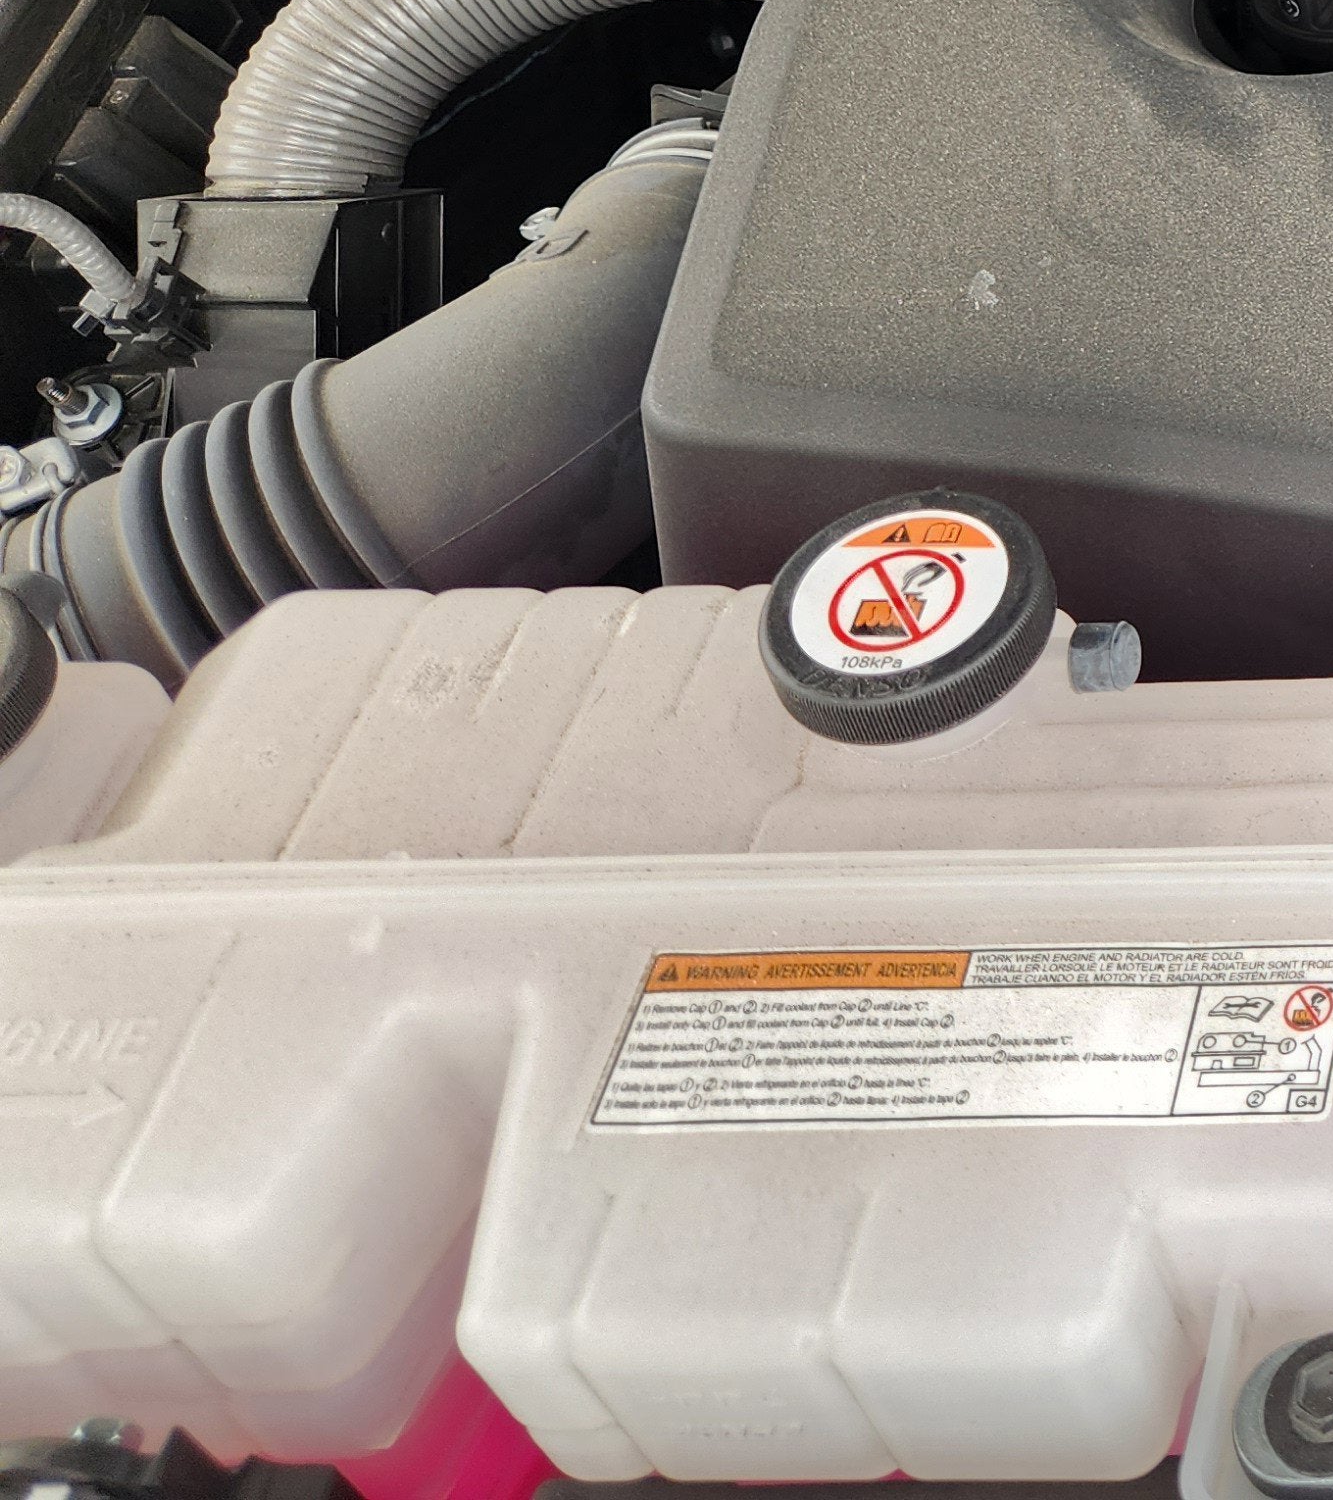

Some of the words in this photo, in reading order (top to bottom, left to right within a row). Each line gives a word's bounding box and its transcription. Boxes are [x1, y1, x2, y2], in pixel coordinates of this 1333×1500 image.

[840, 654, 904, 671] 108kPa
[977, 954, 1013, 964] WORK
[1015, 954, 1051, 963] WHEN
[1053, 953, 1096, 962] ENGINE
[1098, 952, 1123, 961] AND
[1125, 951, 1183, 962] RADIATOR
[1185, 952, 1210, 961] ARE
[685, 964, 761, 981] WARNING
[764, 962, 873, 980] AVERTISSEMENT
[876, 961, 957, 979] ADVERTENCIA
[974, 964, 1040, 973] TRAVAILLER
[1042, 963, 1097, 973] LORSQUE
[1100, 963, 1114, 972] LE
[1115, 962, 1166, 972] MOTEUR
[1168, 962, 1183, 971] ET
[1185, 962, 1199, 971] LE
[1201, 961, 1265, 972] RADIATEUR
[1267, 960, 1299, 970] SONT
[1024, 973, 1075, 983] CUANDO
[1076, 973, 1090, 982] EL
[1094, 972, 1137, 982] MOTOR
[1139, 972, 1147, 982] Y
[1149, 972, 1162, 982] EL
[1165, 972, 1226, 983] RADIADOR
[1295, 1095, 1318, 1108] G4
